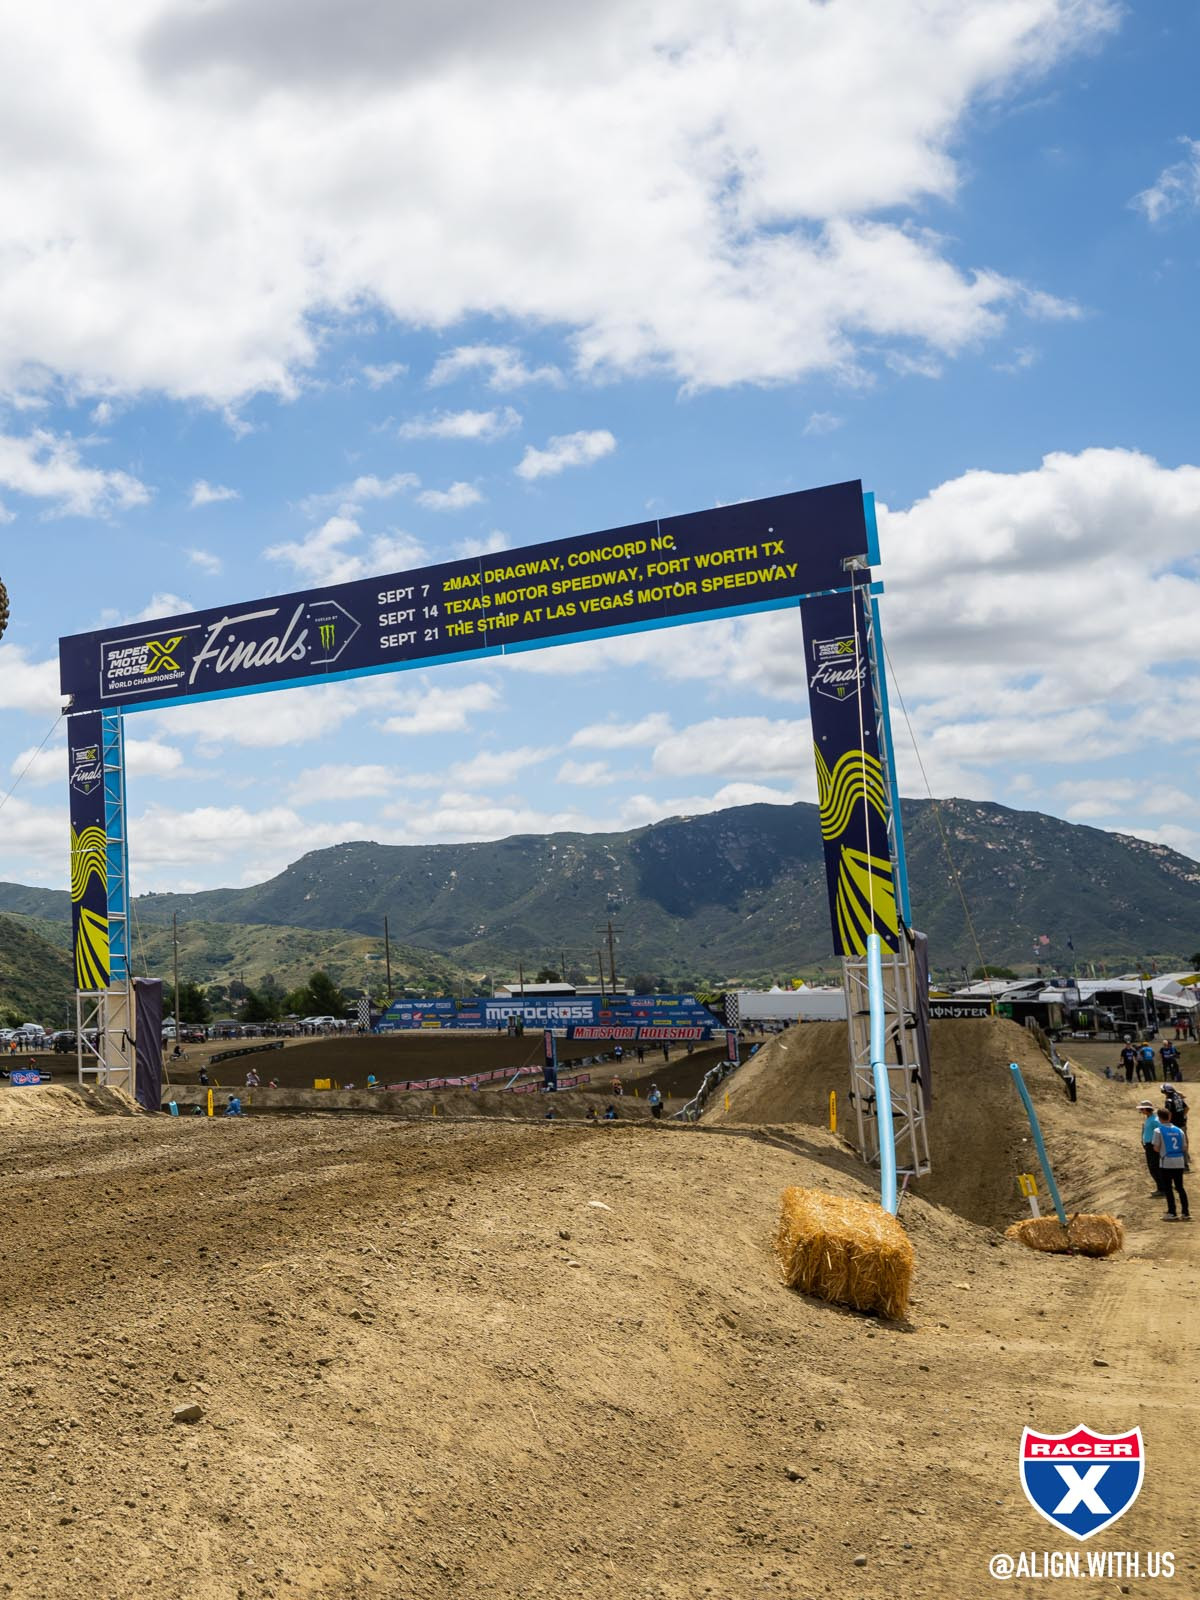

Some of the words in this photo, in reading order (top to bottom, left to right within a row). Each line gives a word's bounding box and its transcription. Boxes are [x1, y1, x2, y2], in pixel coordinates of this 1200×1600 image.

[377, 586, 415, 605] SEPT
[421, 584, 430, 597] 7
[442, 573, 483, 592] zMAX
[484, 556, 565, 584] DRAGWAY,
[567, 539, 647, 568] CONCORD
[650, 535, 675, 552] NC
[378, 608, 416, 627] SEPT
[422, 604, 439, 619] 14
[444, 595, 491, 615] TEXAS
[494, 584, 548, 606] MOTOR
[551, 567, 643, 596] SPEEDWAY,
[646, 557, 691, 578] FORT
[694, 545, 758, 570] WORTH
[761, 539, 785, 556] TX
[379, 631, 417, 649] SEPT
[424, 627, 439, 641] 21
[445, 621, 474, 638] THE
[477, 612, 519, 632] STRIP
[523, 608, 543, 624] AT
[546, 602, 577, 620] LAS
[579, 591, 634, 614] VEGAS
[637, 581, 698, 605] MOTOR
[701, 563, 799, 593] SPEEDWAY
[107, 645, 149, 661] SUPER
[189, 603, 309, 685] Finals
[110, 654, 148, 669] MOTO
[107, 664, 149, 679] CROSS
[108, 679, 133, 690] WORLD
[133, 671, 186, 686] CHAMPIONSHIP
[810, 657, 867, 688] Finals
[70, 762, 102, 785] Finals
[486, 1007, 594, 1020] MOTOCROSS
[639, 1026, 705, 1039] HOLESHOT
[1171, 1137, 1179, 1150] 2
